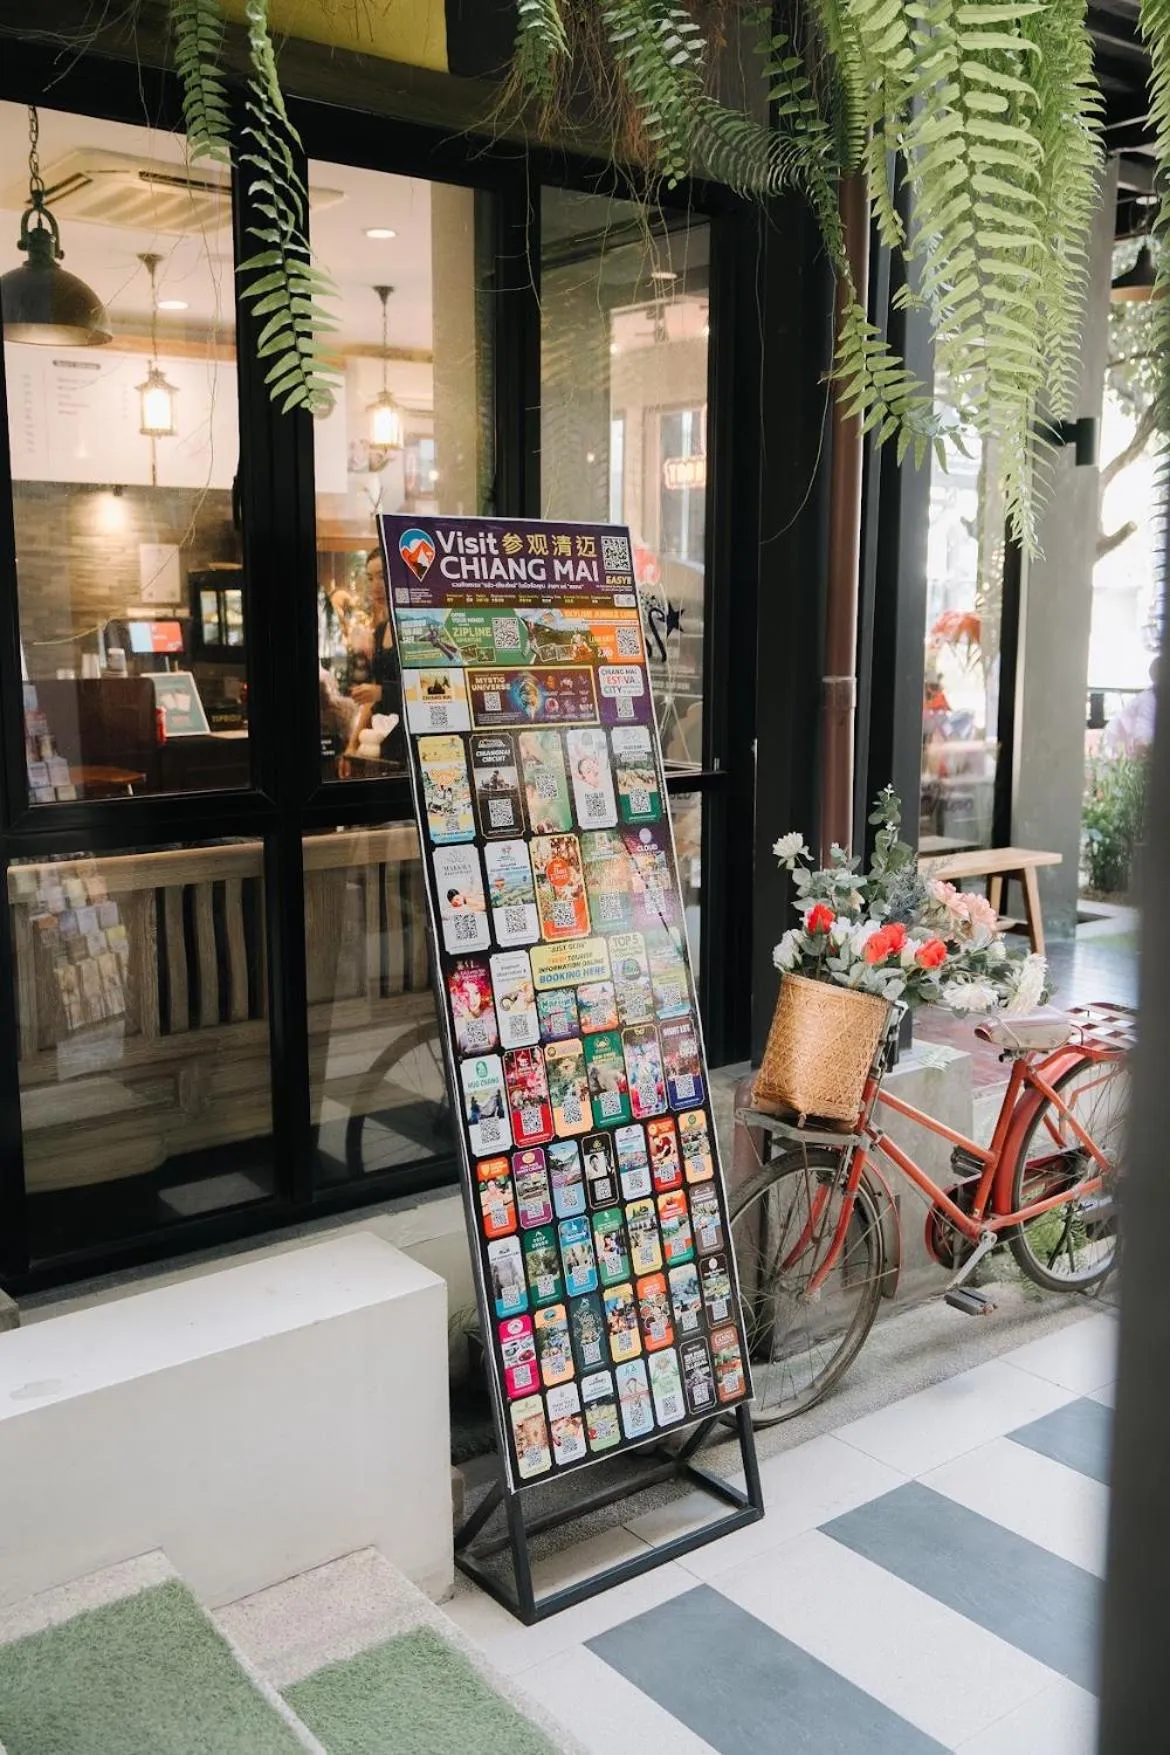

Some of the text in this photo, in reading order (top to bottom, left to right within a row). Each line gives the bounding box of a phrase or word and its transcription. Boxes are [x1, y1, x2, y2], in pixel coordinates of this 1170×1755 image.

[435, 530, 598, 558] Visit 参观清迈
[440, 556, 599, 582] CHIANG MAI
[452, 626, 493, 637] ZIPLINE
[471, 683, 511, 691] UNIVERSE
[612, 933, 639, 947] TOP 5
[539, 970, 581, 984] BOOKING
